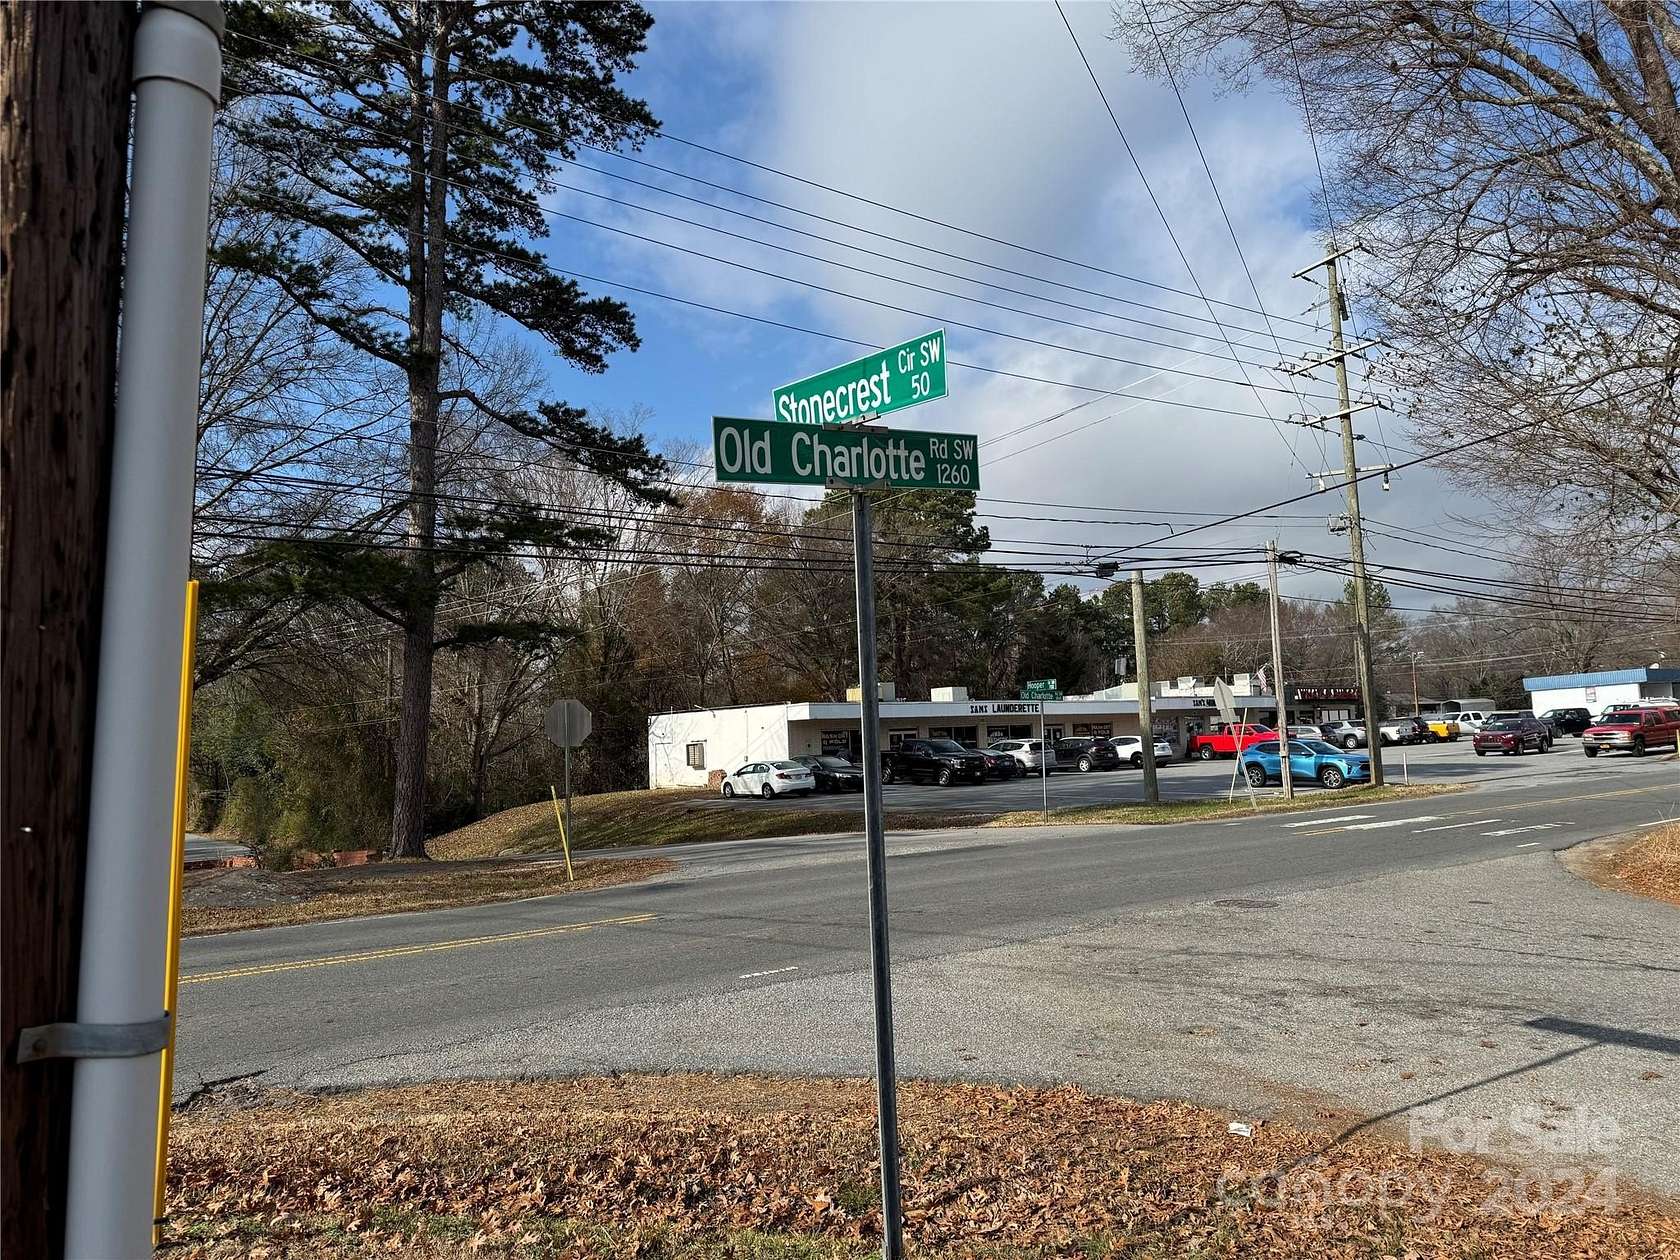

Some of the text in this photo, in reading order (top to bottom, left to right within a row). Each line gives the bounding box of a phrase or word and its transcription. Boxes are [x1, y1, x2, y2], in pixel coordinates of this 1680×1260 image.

[897, 337, 941, 374] Cir SW
[779, 359, 892, 423] Stonecrest
[911, 371, 931, 399] 50
[719, 426, 926, 480] Old Charlotte
[929, 438, 975, 460] Rd SW
[936, 464, 970, 485] 1260
[992, 703, 1040, 713] LAUNDERETTE
